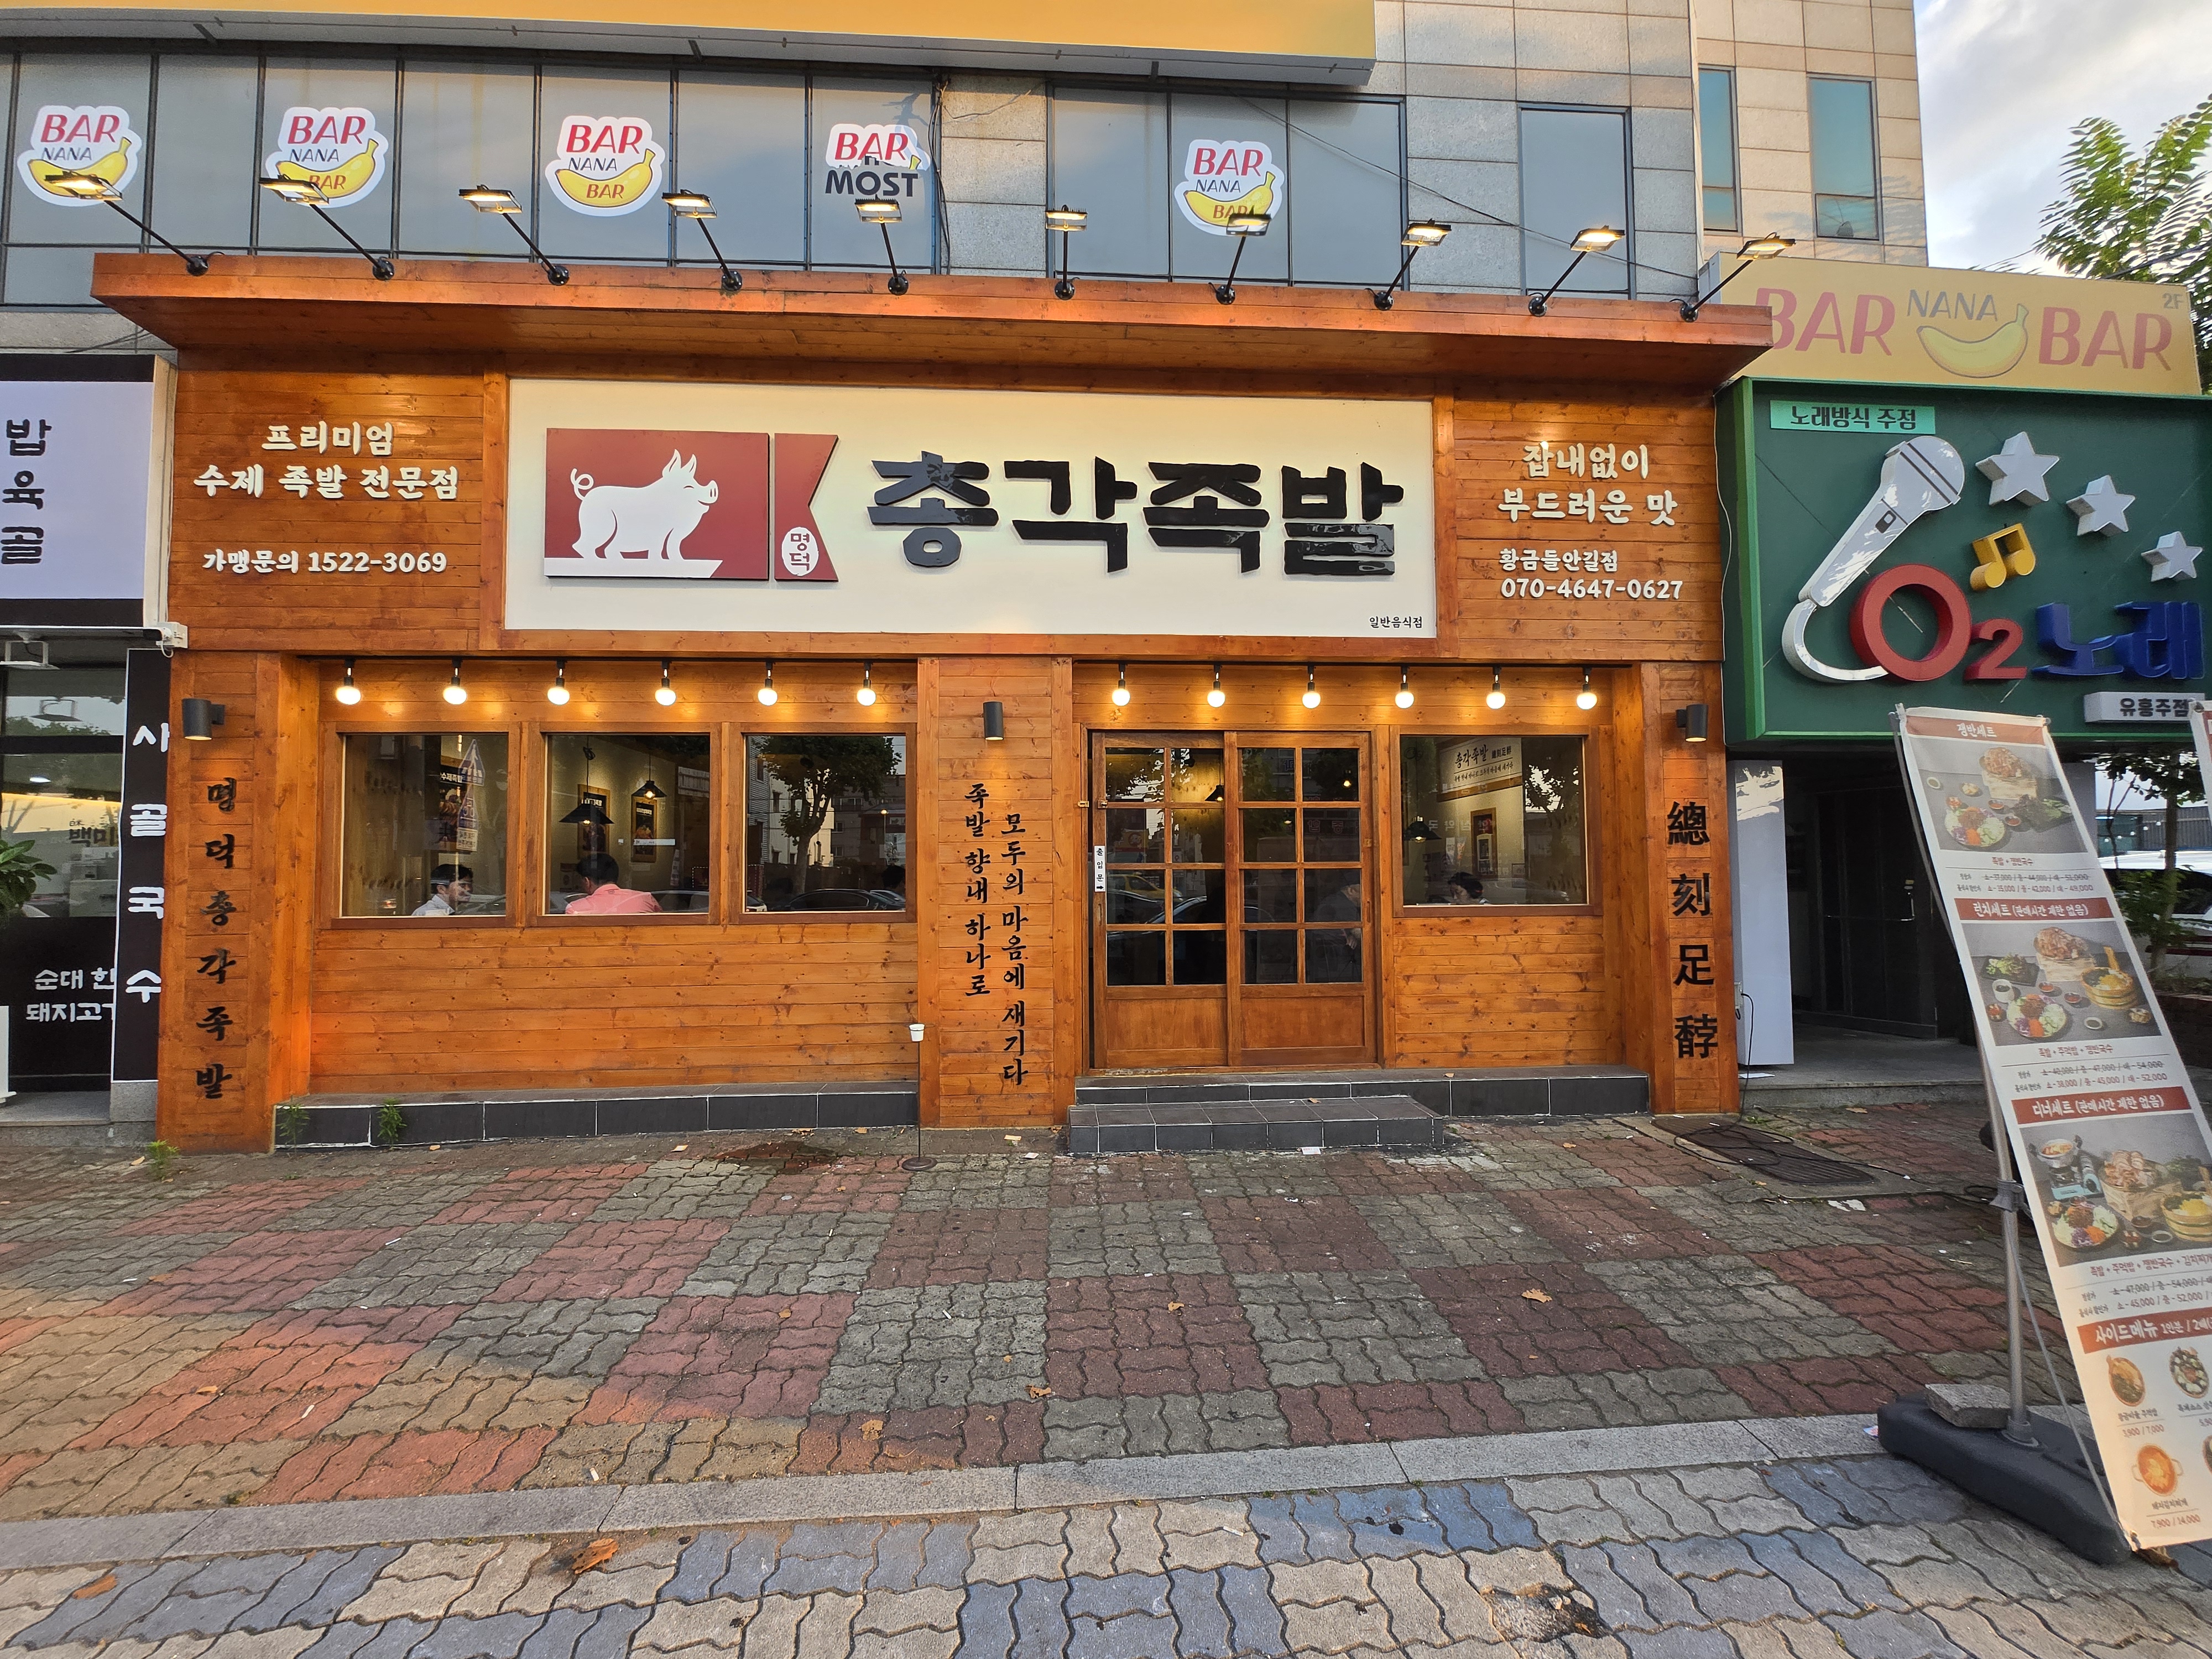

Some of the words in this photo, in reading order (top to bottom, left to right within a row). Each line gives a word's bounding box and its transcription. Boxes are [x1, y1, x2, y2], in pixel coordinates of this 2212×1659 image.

[40, 114, 120, 143] BAR
[288, 116, 367, 145] BAR
[566, 125, 643, 153] BAR
[41, 147, 92, 161] NANA
[290, 149, 340, 163] NANA
[834, 133, 909, 161] BAR
[568, 158, 617, 171] NANA
[1193, 148, 1264, 176] BAR
[309, 175, 346, 190] BAR
[586, 184, 625, 199] BAR
[825, 170, 919, 196] MOST
[1195, 179, 1241, 193] NANA
[1213, 205, 1248, 218] BAR
[1907, 290, 1998, 321] NANA
[2163, 293, 2183, 309] 2F
[1755, 287, 1896, 356] BAR
[2038, 306, 2172, 371] BAR
[1791, 406, 1870, 427] 노래방식
[1877, 409, 1917, 429] 주점
[6, 419, 51, 457] 밥
[262, 420, 394, 457] 프리미엄
[1523, 441, 1650, 480] 잡내없이
[3, 470, 44, 510] 육
[194, 463, 264, 498] 수제
[278, 464, 348, 499] 족발
[360, 465, 459, 500] 전문점
[867, 451, 1405, 576] 총각족발
[1498, 487, 1634, 525] 부드러운
[1647, 489, 1678, 526] 맛
[203, 549, 300, 575] 가맹문의
[308, 551, 447, 573] 1522-3069
[790, 533, 810, 572] 명덕
[1499, 549, 1619, 573] 황금들안길점
[1501, 578, 1683, 601] 070-4647-0627
[1369, 616, 1422, 629] 일반음식점
[2032, 601, 2204, 680] 노래
[2120, 698, 2190, 717] 유흥주점
[1957, 722, 1997, 738] 쟁반세트
[1455, 744, 1488, 768] 총각족발
[964, 783, 990, 837] 족발
[126, 722, 170, 1003] 사골국수
[1000, 813, 1026, 895] 모두의
[965, 848, 990, 904] 향내
[1973, 901, 2011, 917] 런치세트
[964, 914, 992, 997] 하나로
[1001, 905, 1029, 990] 마음에
[34, 969, 83, 990] 순대
[2032, 1098, 2075, 1118] 디너세트
[2138, 1094, 2164, 1109] 없음)
[2177, 1292, 2203, 1302] 52,000
[2095, 1319, 2158, 1344] 사이드메뉴
